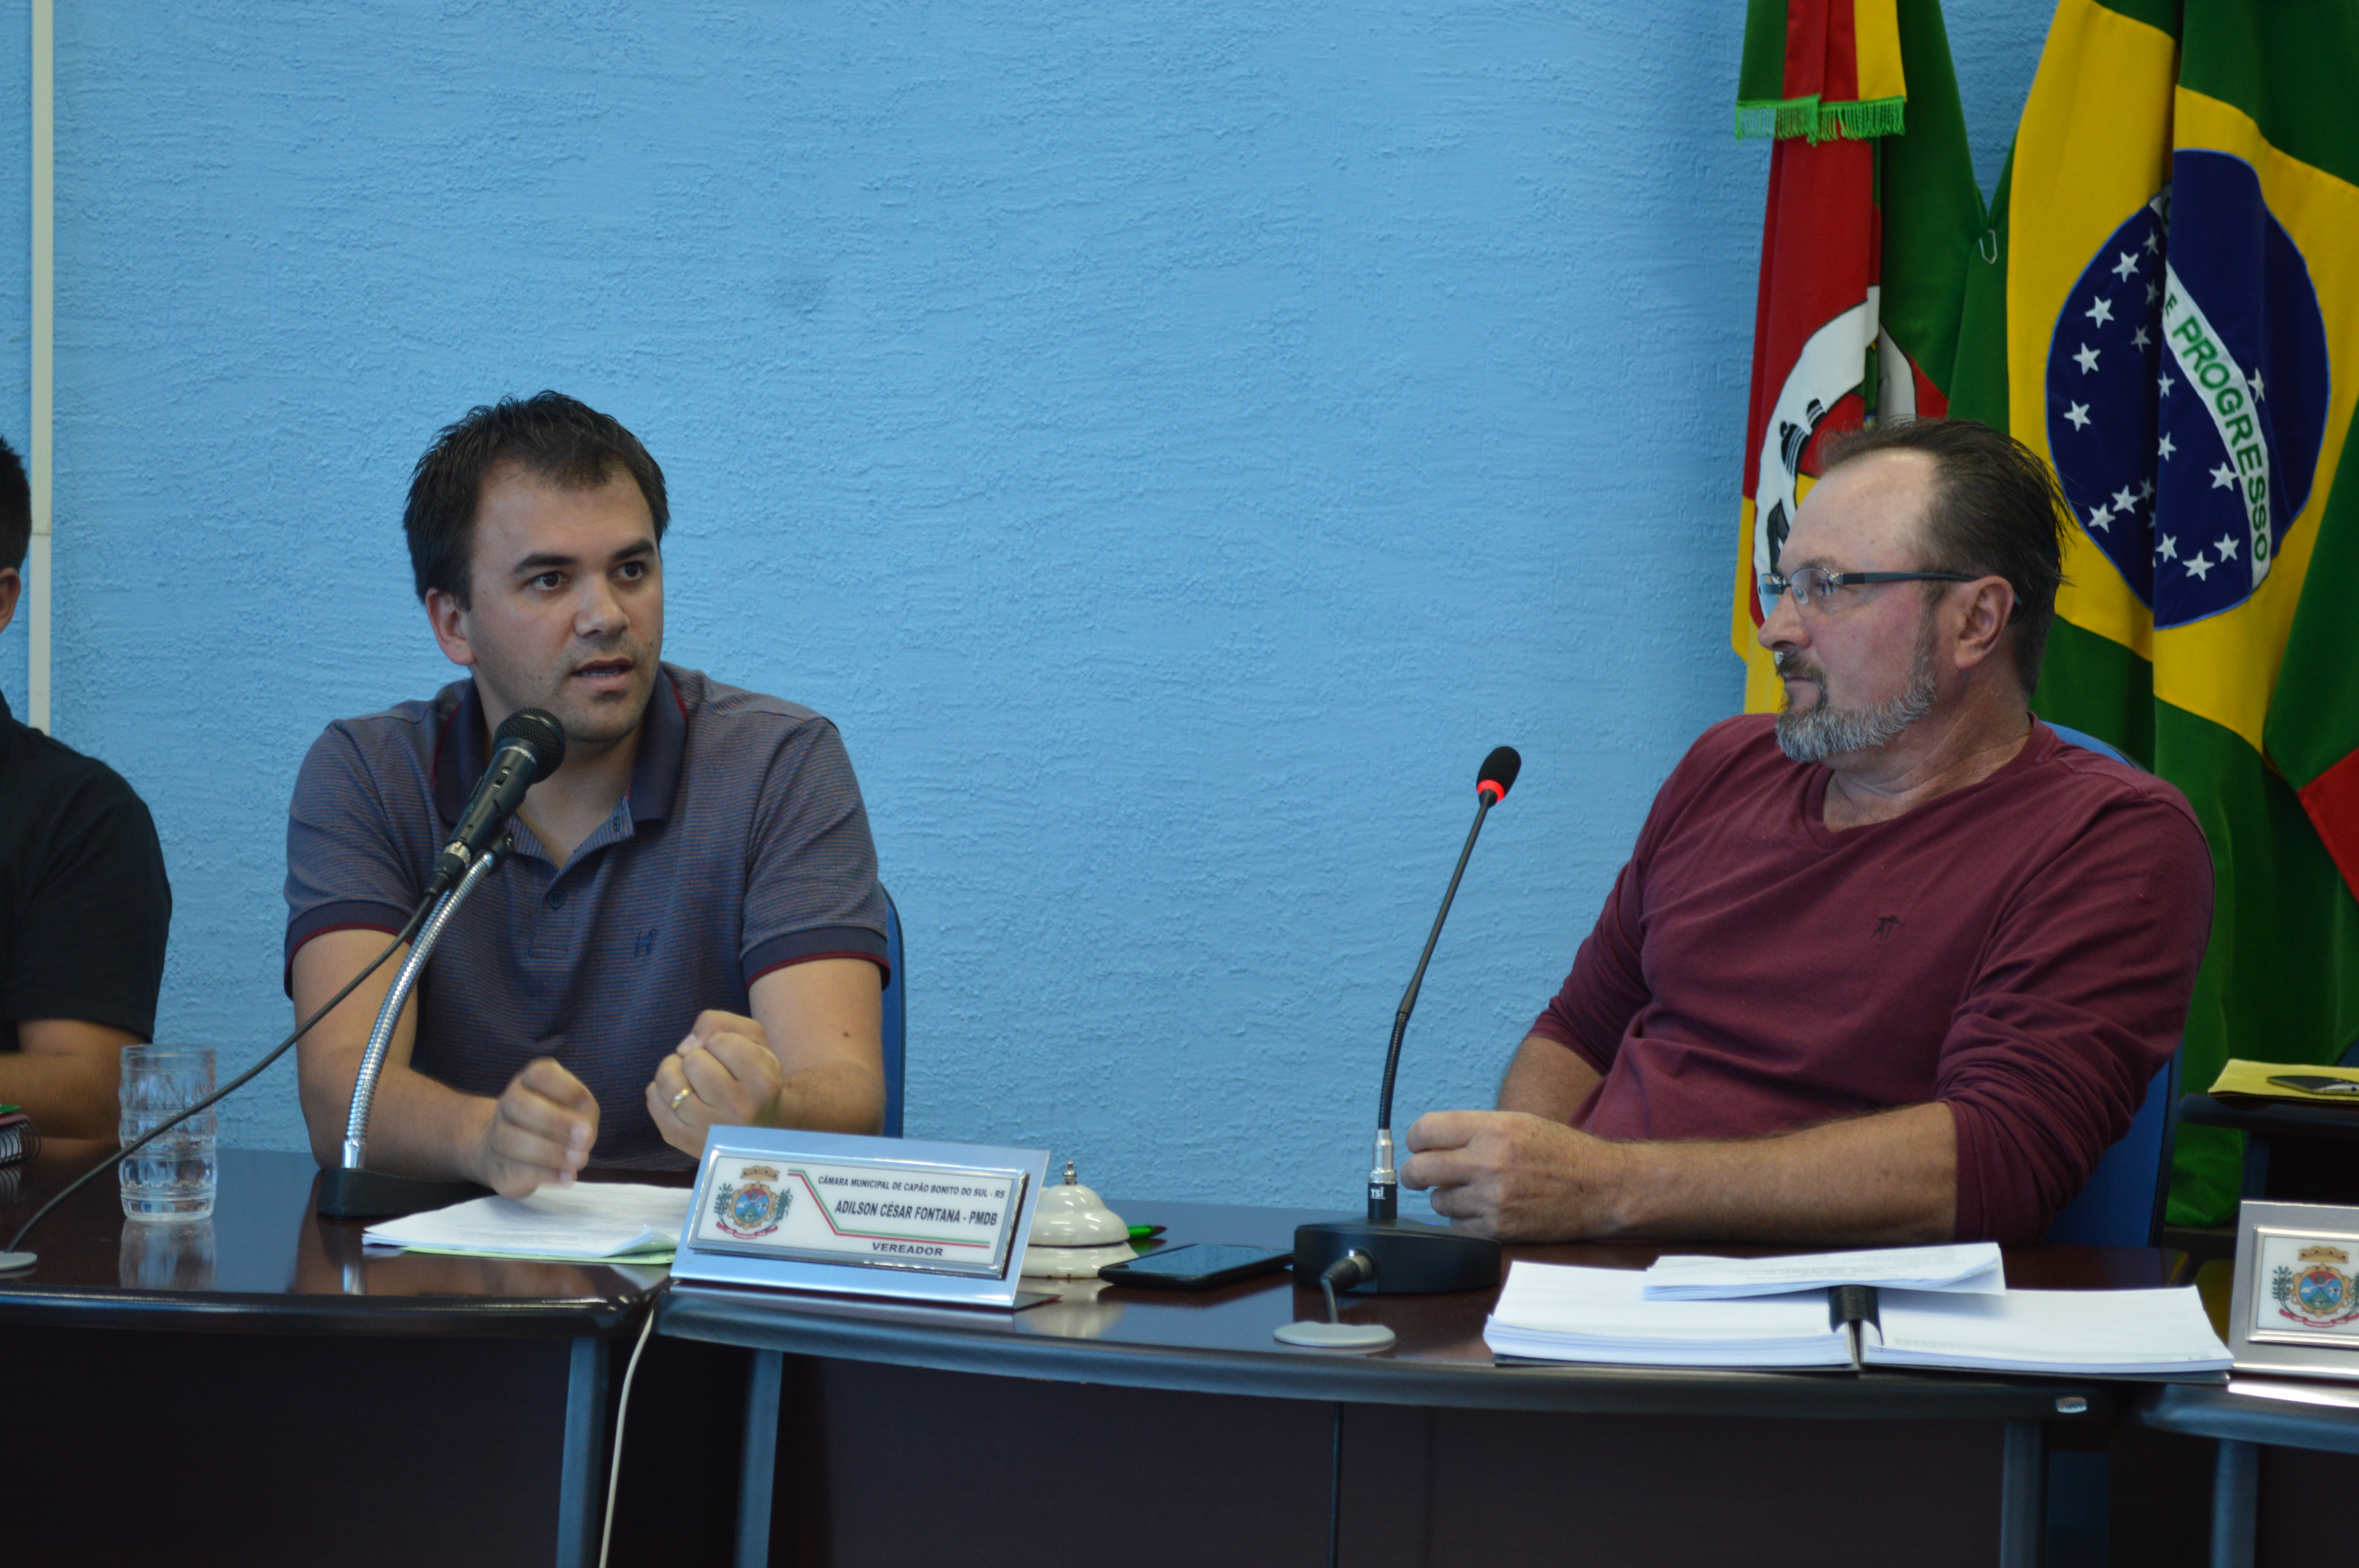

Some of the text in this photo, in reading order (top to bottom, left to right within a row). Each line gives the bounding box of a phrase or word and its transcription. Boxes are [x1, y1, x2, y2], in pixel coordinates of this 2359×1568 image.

[2165, 293, 2267, 562] E PROGRESSO
[850, 1179, 890, 1190] MUNICIPAL
[892, 1182, 902, 1191] DE
[904, 1183, 929, 1193] CAPÃO
[931, 1185, 959, 1195] BONITO
[973, 1189, 988, 1198] SUL
[994, 1190, 1005, 1199] RS
[835, 1200, 878, 1216] ADILSON
[880, 1201, 913, 1219] CÉSAR
[914, 1207, 960, 1223] FONTANA
[969, 1211, 998, 1226] PMDB
[872, 1242, 943, 1257] VEREADOR
